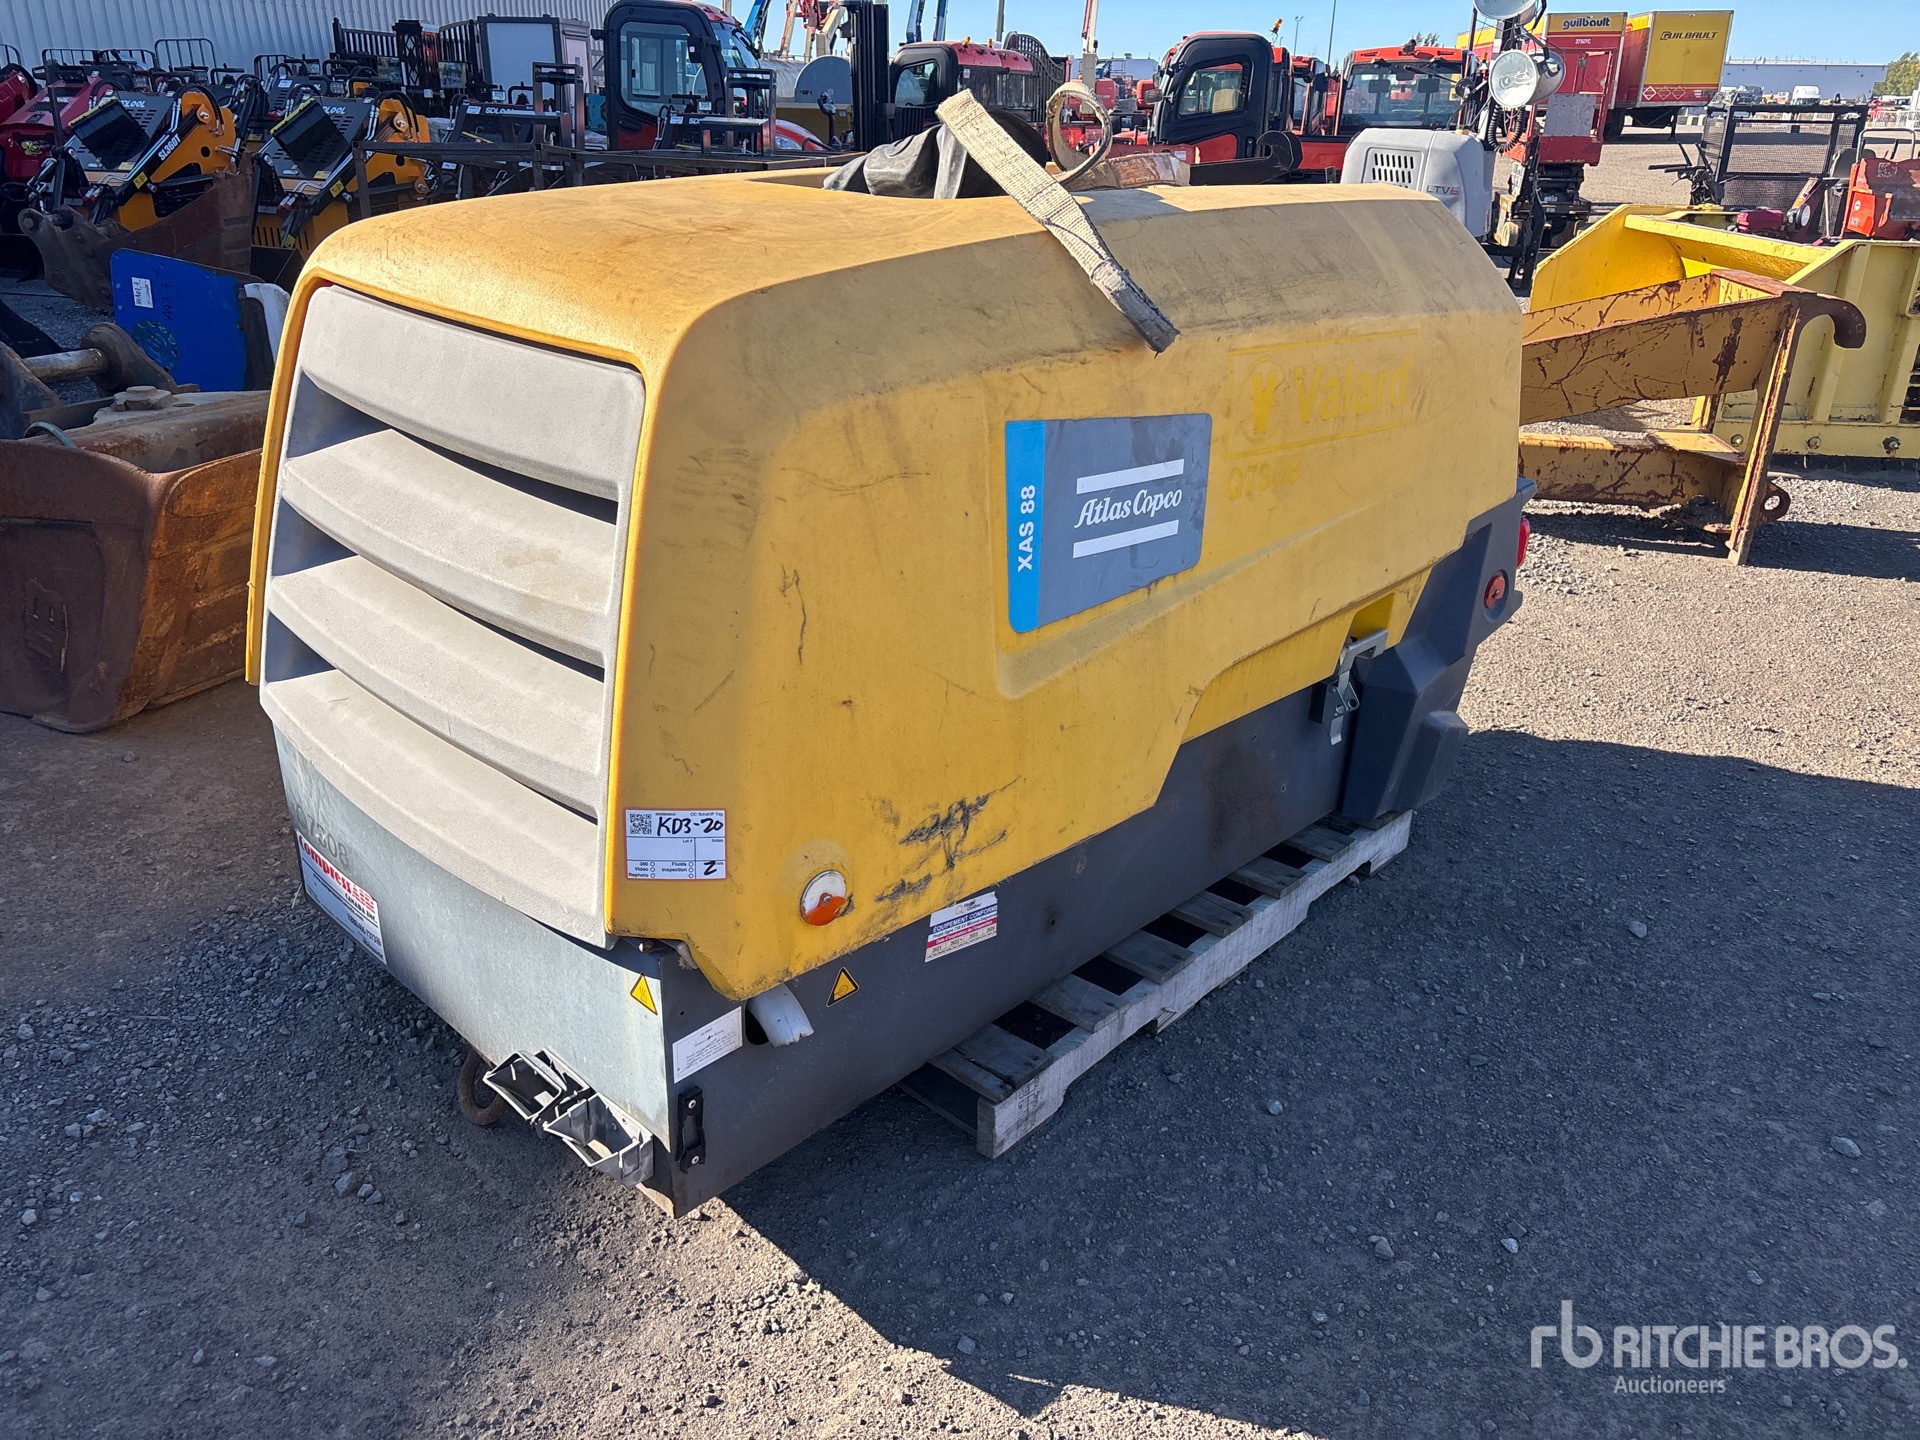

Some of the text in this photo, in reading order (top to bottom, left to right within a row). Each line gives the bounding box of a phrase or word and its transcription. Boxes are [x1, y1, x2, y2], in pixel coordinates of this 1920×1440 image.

[1563, 18, 1610, 30] guilbault
[1660, 31, 1718, 40] GUILBAULT
[1296, 356, 1410, 424] Valard
[1074, 489, 1183, 529] Atlas Copco
[1018, 484, 1036, 573] XAS 88
[657, 816, 724, 837] KD3-20
